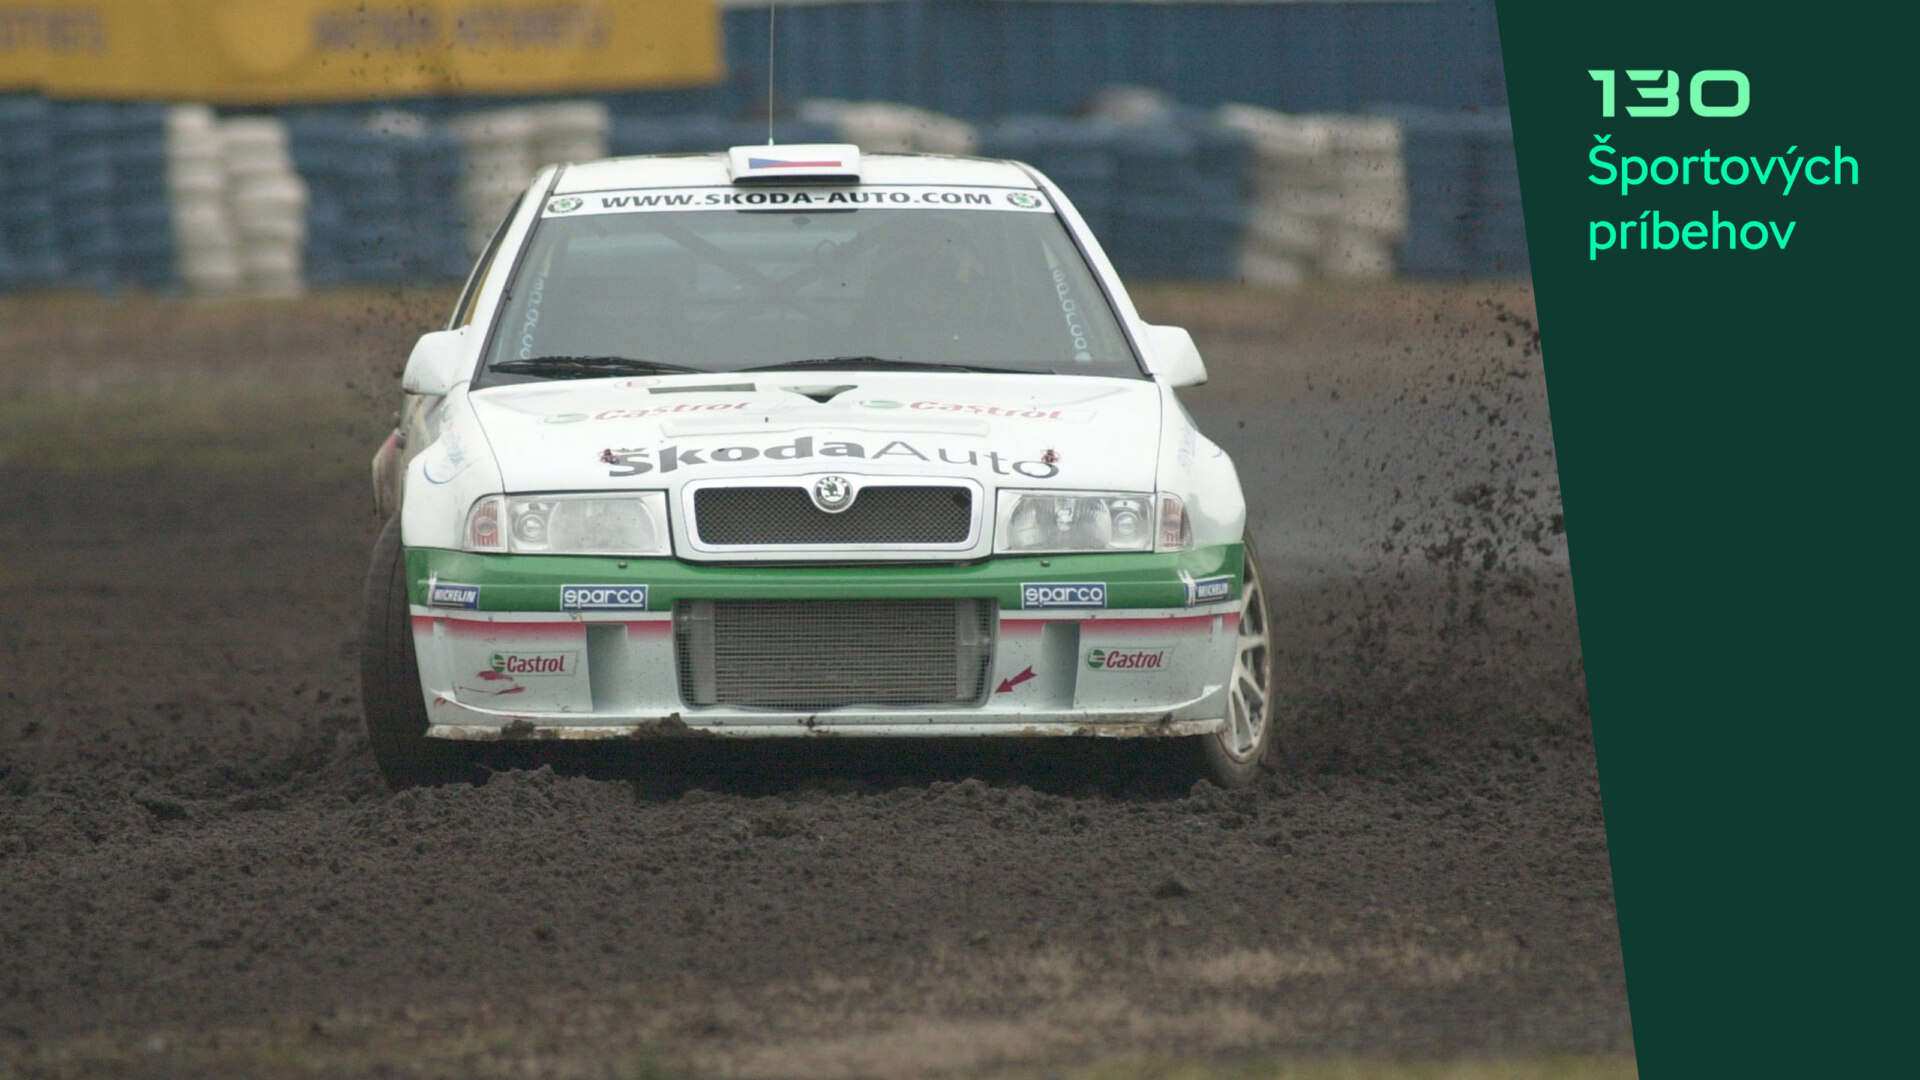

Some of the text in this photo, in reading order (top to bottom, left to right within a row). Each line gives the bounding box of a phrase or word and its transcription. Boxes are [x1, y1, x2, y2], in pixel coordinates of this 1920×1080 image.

[601, 192, 992, 209] WWW.SKODA-AUTO.COM
[594, 401, 751, 420] Castrol
[909, 401, 1064, 420] Castrol
[433, 588, 476, 603] MICHELIN
[563, 587, 644, 608] sparco
[1024, 584, 1103, 607] sparco
[1198, 582, 1229, 598] MICHELIN
[506, 654, 565, 674] Castrol
[1106, 650, 1163, 669] Castrol
